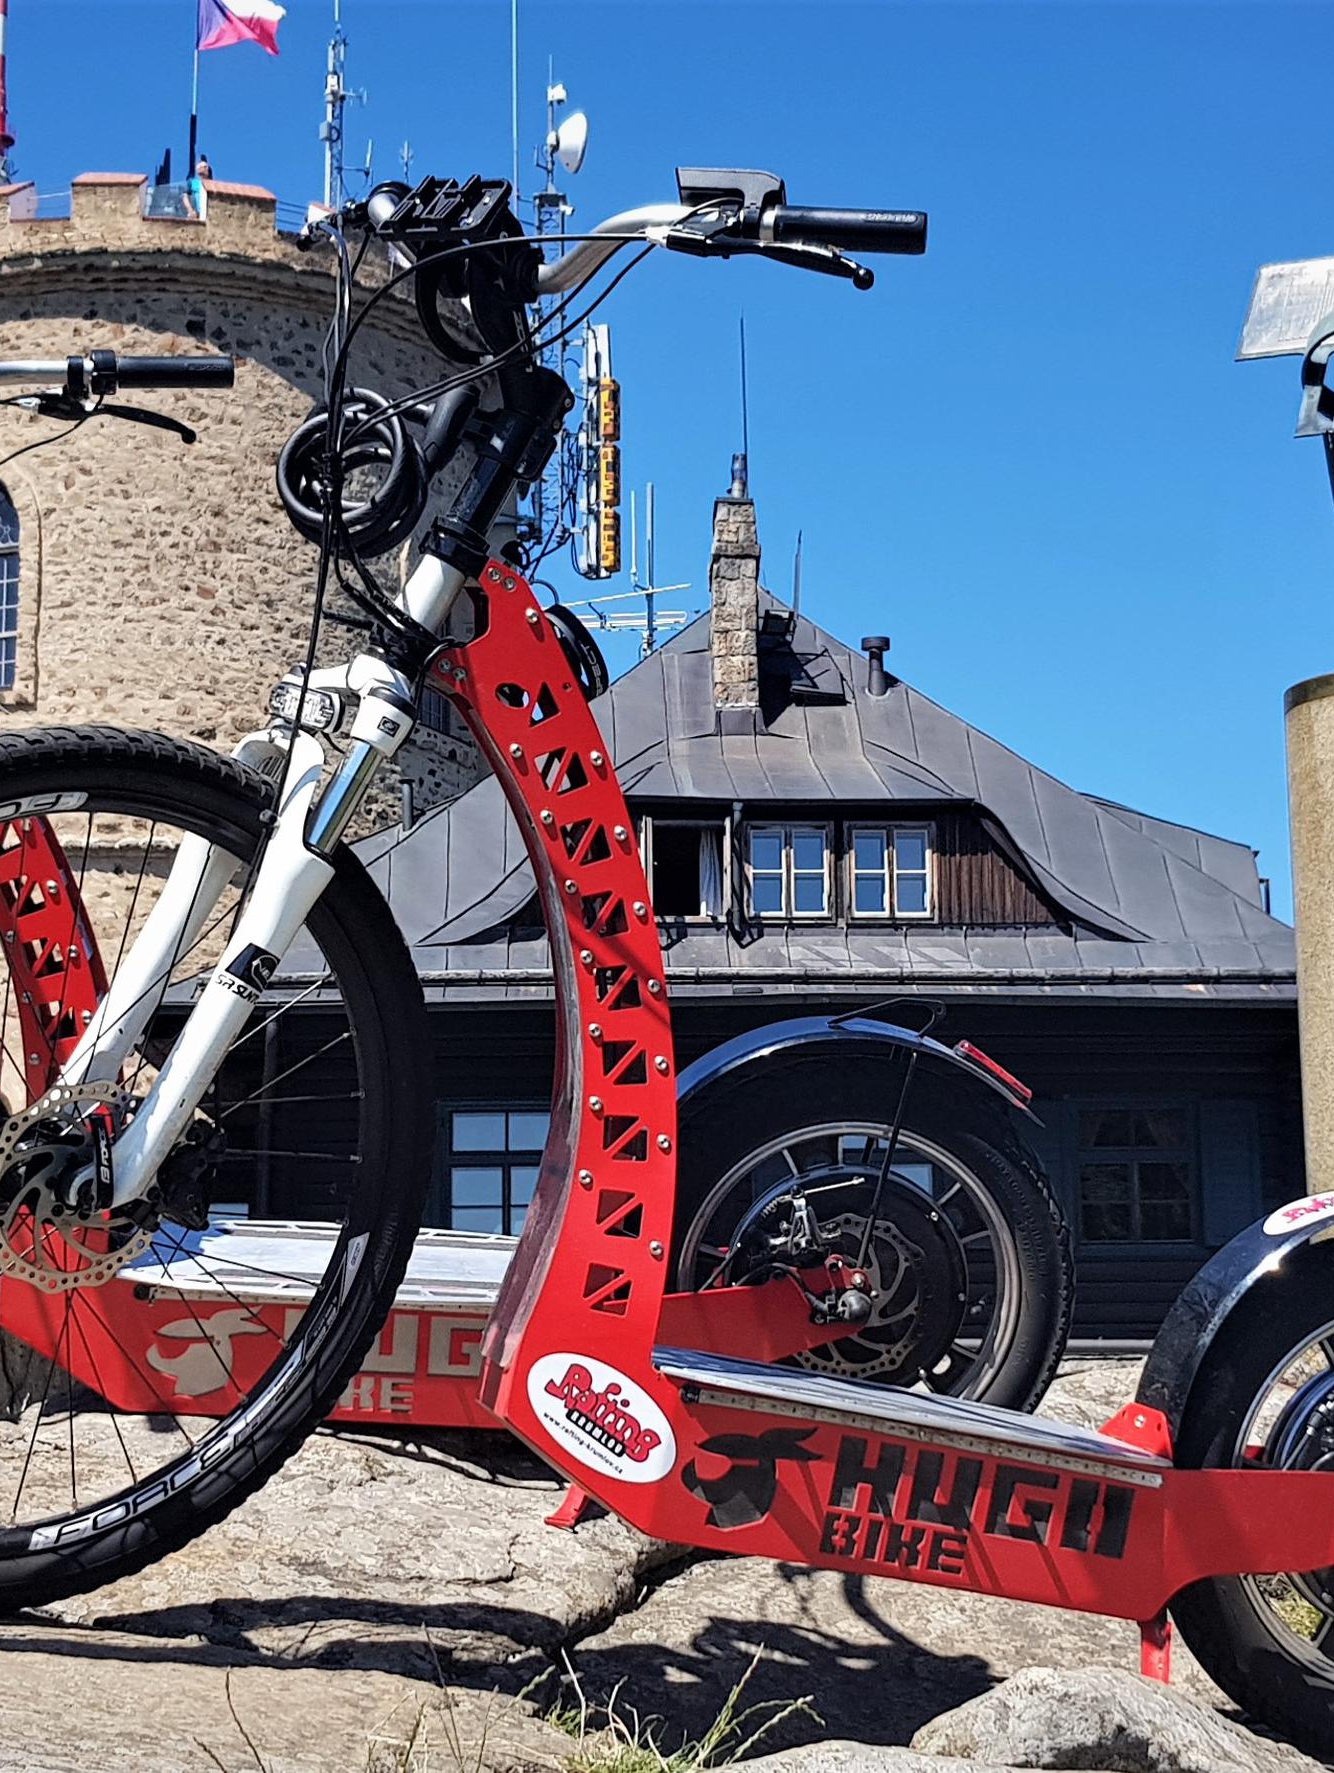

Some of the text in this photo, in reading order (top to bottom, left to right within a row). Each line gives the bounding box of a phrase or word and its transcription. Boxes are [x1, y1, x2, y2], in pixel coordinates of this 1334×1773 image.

[215, 973, 236, 990] SR
[543, 1363, 662, 1463] Rafting
[54, 1432, 230, 1545] FORCE
[828, 1435, 1135, 1559] HUGO
[818, 1513, 969, 1576] BIKE
